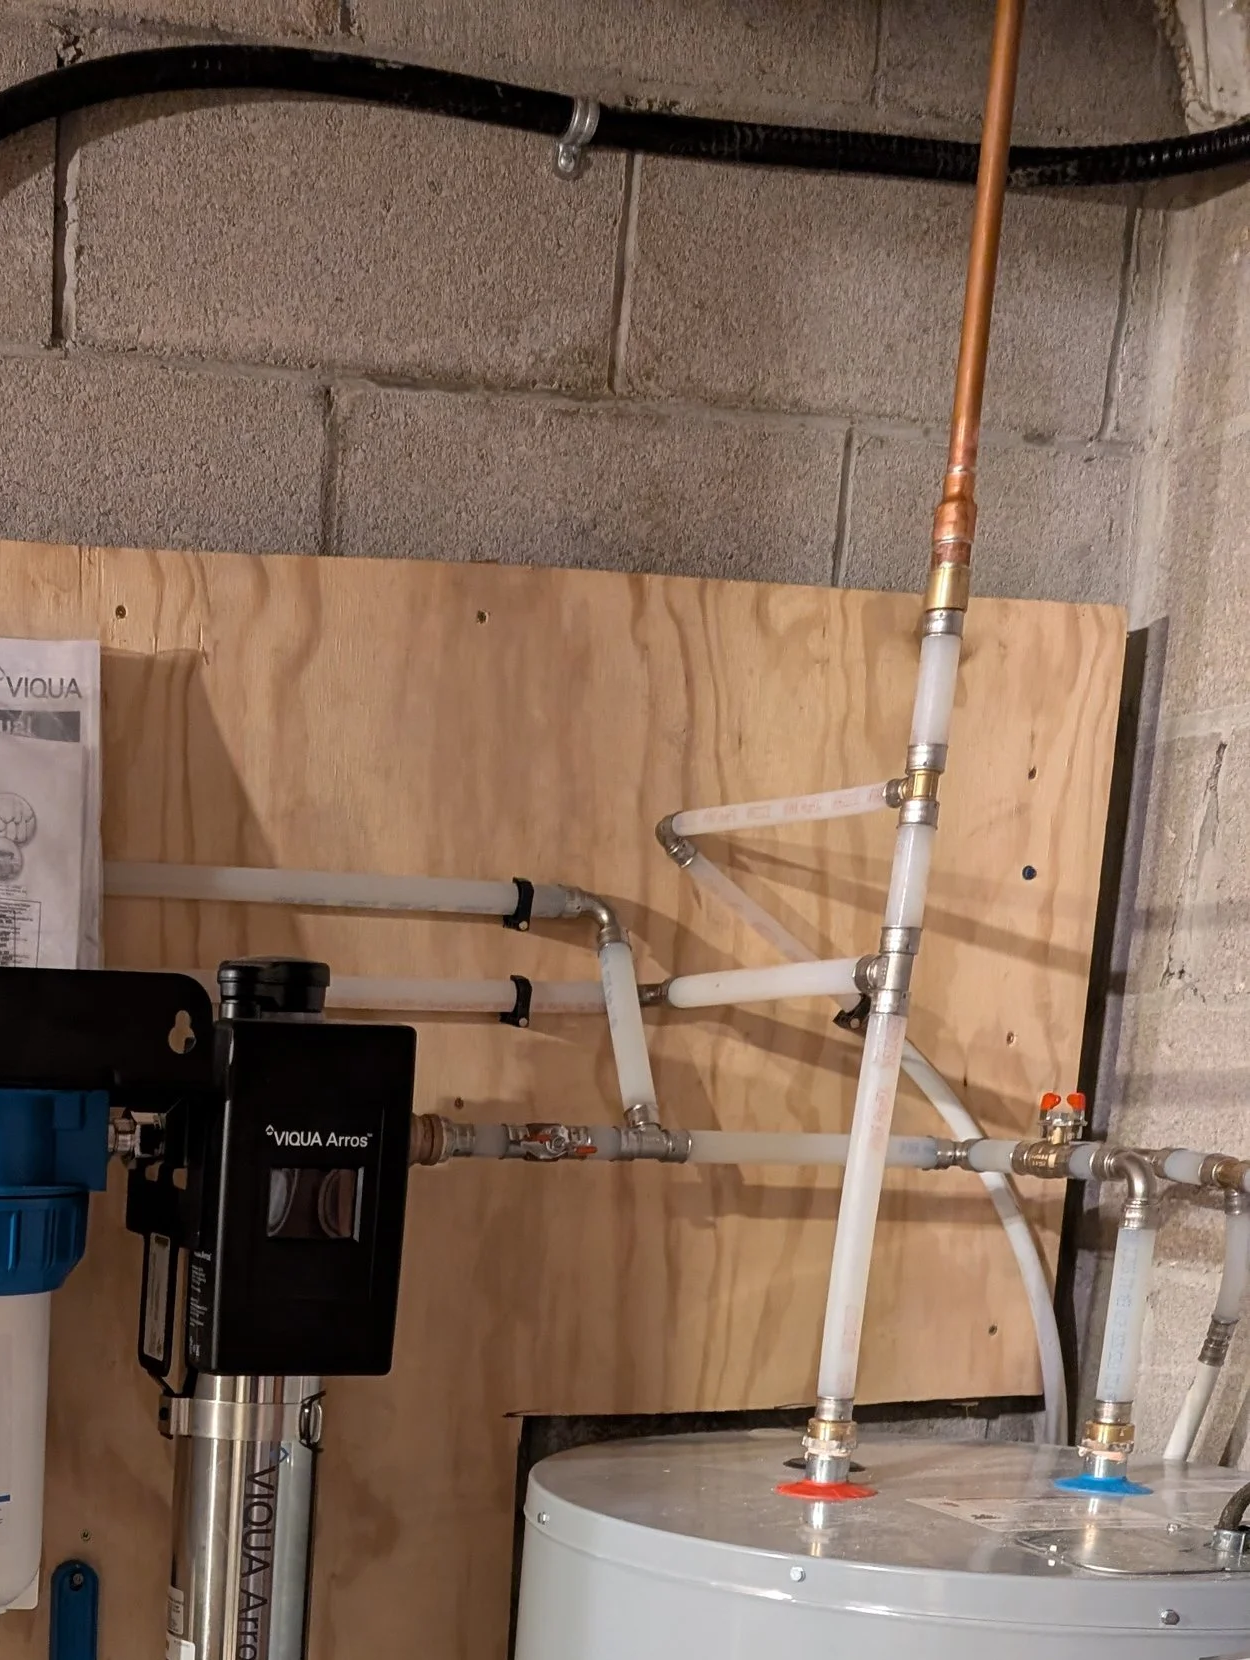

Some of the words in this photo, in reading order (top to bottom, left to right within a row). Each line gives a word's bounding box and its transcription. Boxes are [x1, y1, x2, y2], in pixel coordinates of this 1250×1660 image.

[6, 676, 82, 699] VIQUA
[274, 1130, 323, 1147] VIQUA
[326, 1131, 368, 1148] Arros
[241, 1465, 278, 1579] VIQUA
